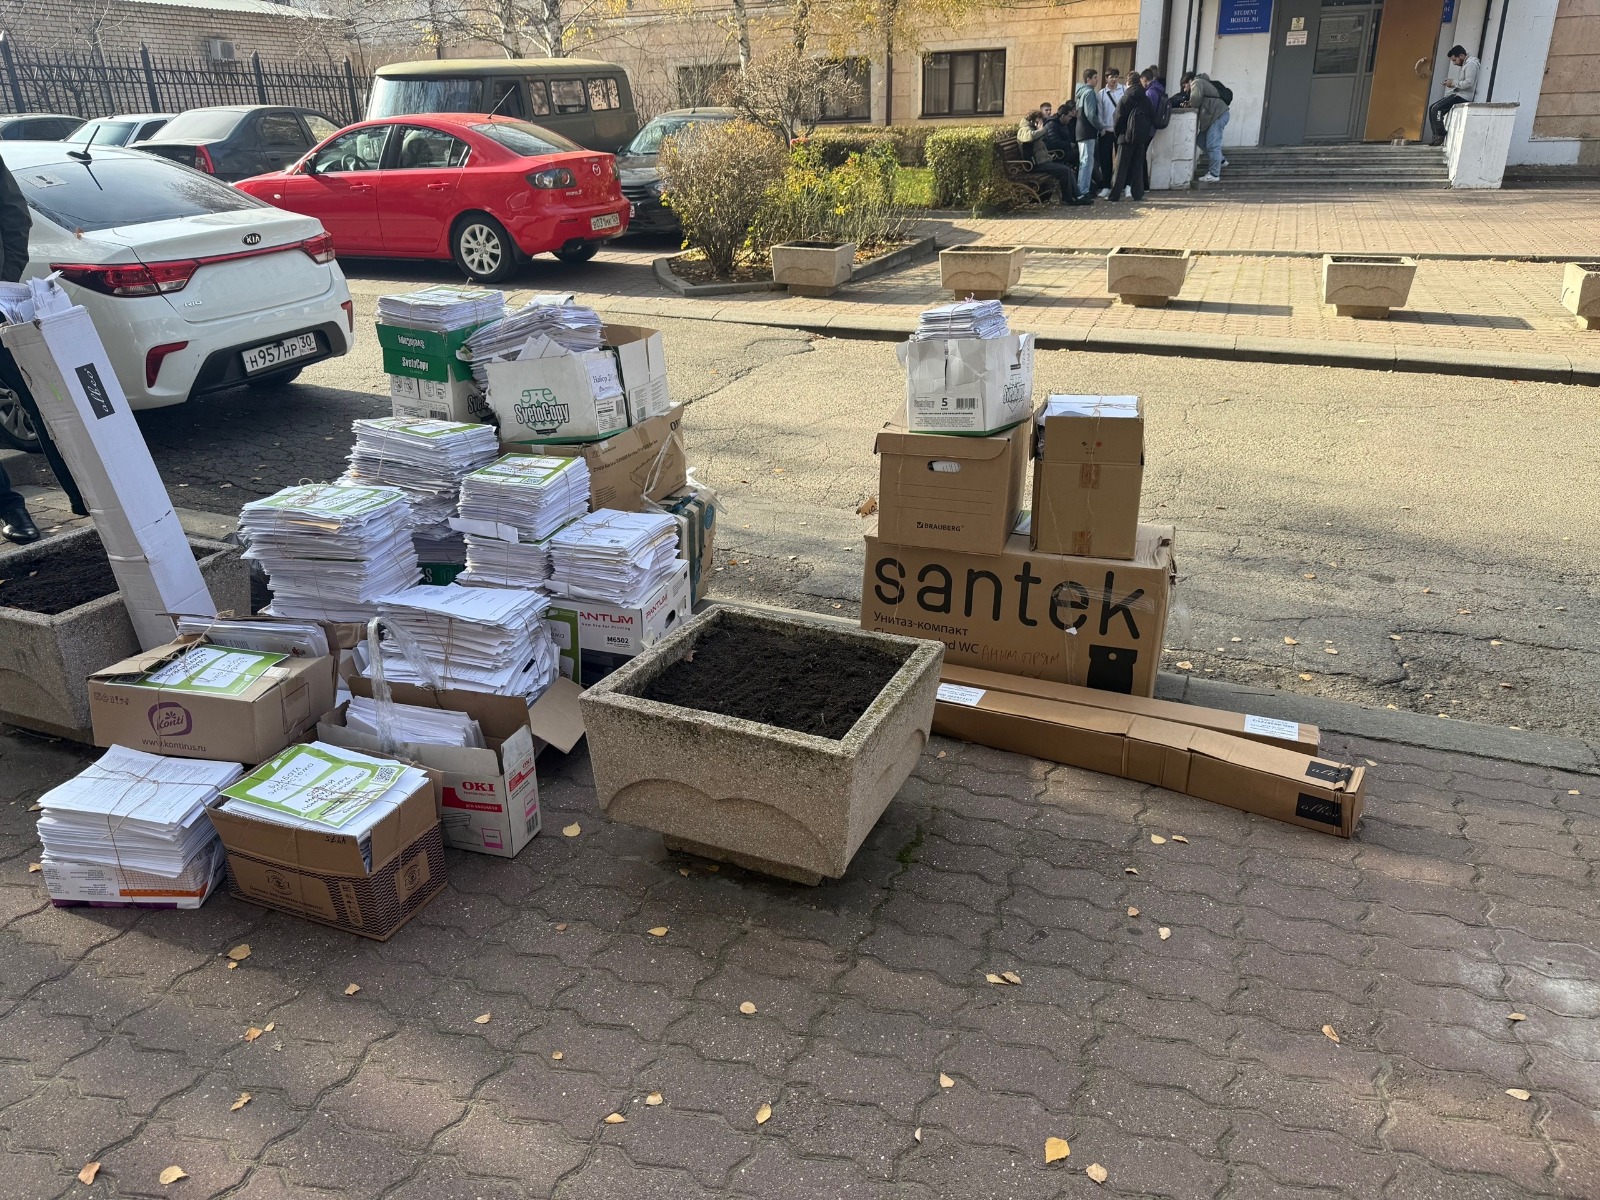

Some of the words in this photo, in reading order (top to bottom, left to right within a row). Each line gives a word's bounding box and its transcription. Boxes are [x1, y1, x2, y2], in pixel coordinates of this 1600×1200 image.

[246, 234, 261, 244] KIA
[299, 335, 312, 348] 30
[402, 356, 429, 372] SvetoCopy
[941, 397, 948, 407] 5
[514, 402, 570, 425] SvetoCopy
[924, 522, 961, 532] BRAUBERG
[874, 557, 1145, 640] santek
[580, 612, 634, 625] ANTUM
[873, 611, 969, 636] Унитаз-компакт
[606, 636, 629, 644] M6502
[462, 781, 496, 792] OKI
